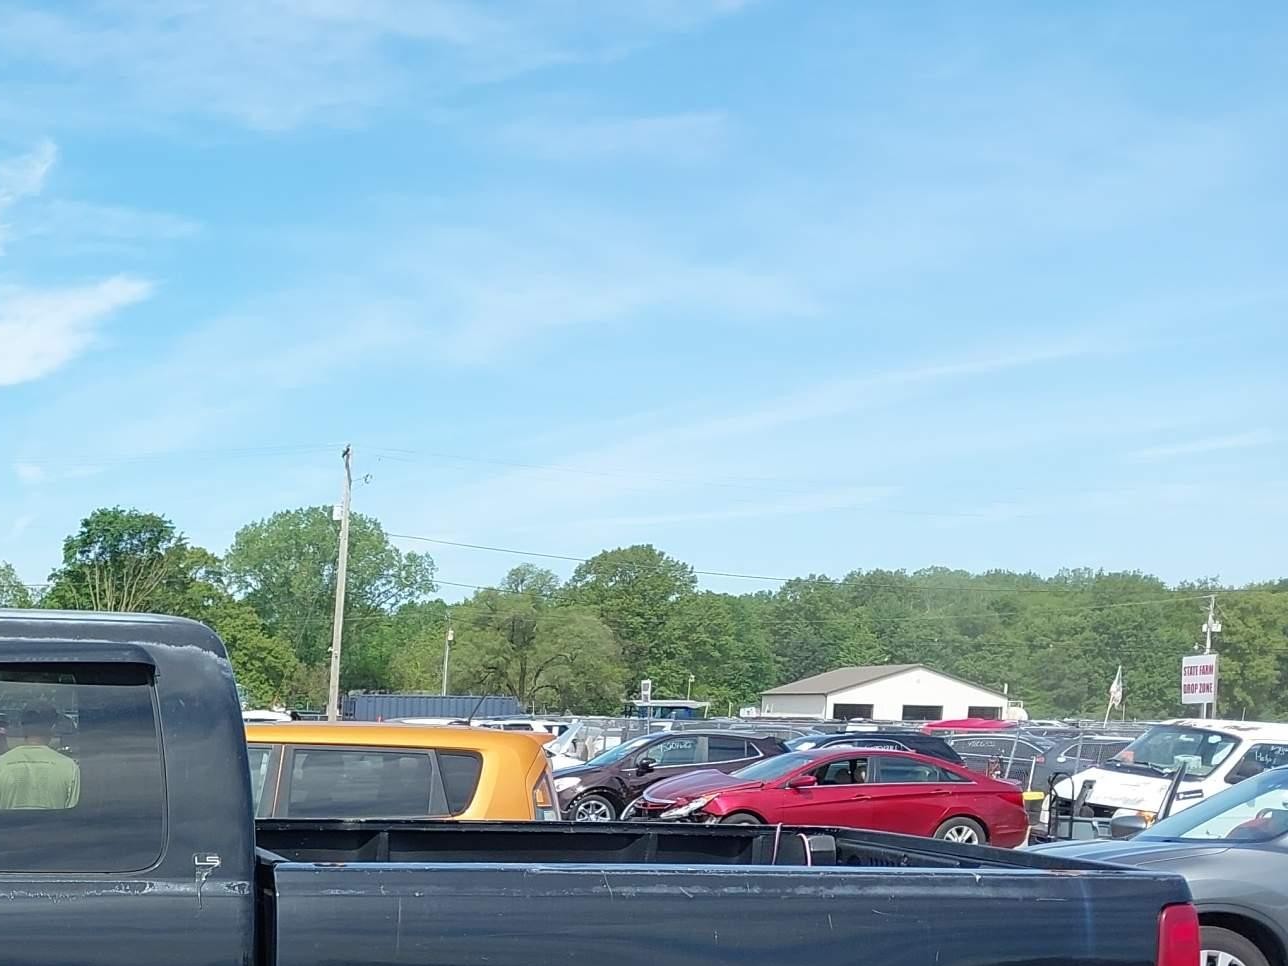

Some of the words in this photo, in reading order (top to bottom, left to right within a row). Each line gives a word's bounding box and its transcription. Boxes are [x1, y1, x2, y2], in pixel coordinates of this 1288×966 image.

[1183, 665, 1199, 677] STATE
[1199, 664, 1214, 676] FARM
[1183, 683, 1199, 694] DROP
[1199, 682, 1213, 694] ZONE
[194, 855, 220, 866] LS
